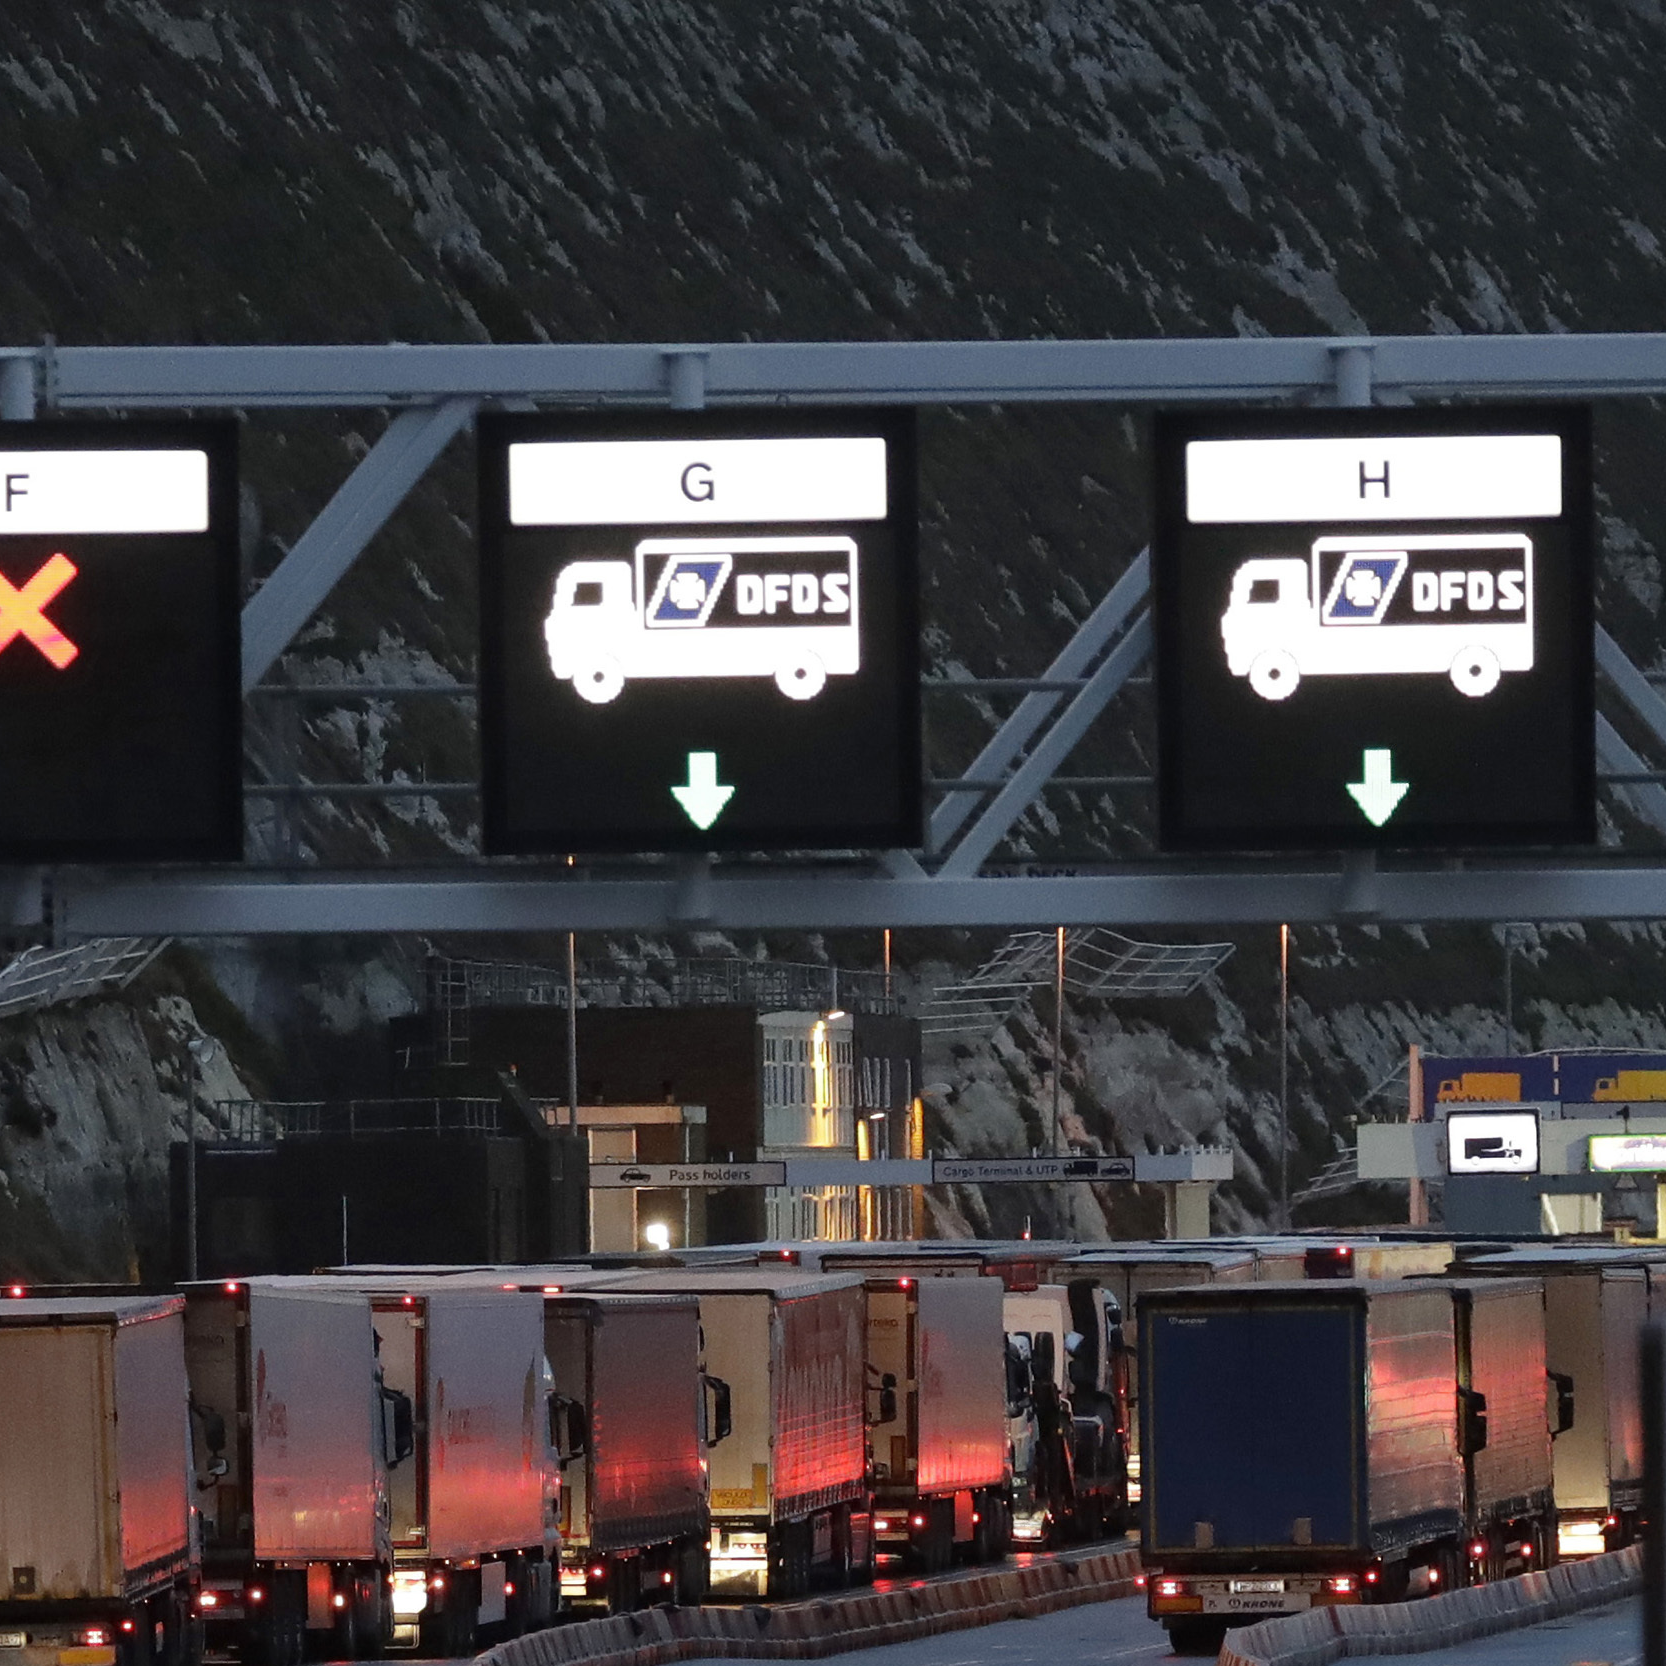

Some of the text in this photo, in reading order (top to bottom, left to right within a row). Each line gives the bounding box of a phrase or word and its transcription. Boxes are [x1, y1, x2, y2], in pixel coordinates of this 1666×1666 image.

[5, 473, 30, 512] F
[680, 463, 717, 503] G
[1360, 461, 1390, 500] H
[734, 571, 851, 616] DFDS
[1412, 569, 1526, 612] DFDS
[669, 1169, 751, 1181] Pass holders
[942, 1165, 1058, 1178] Cargo Terminal & UTP
[1242, 1600, 1285, 1609] KRONE
